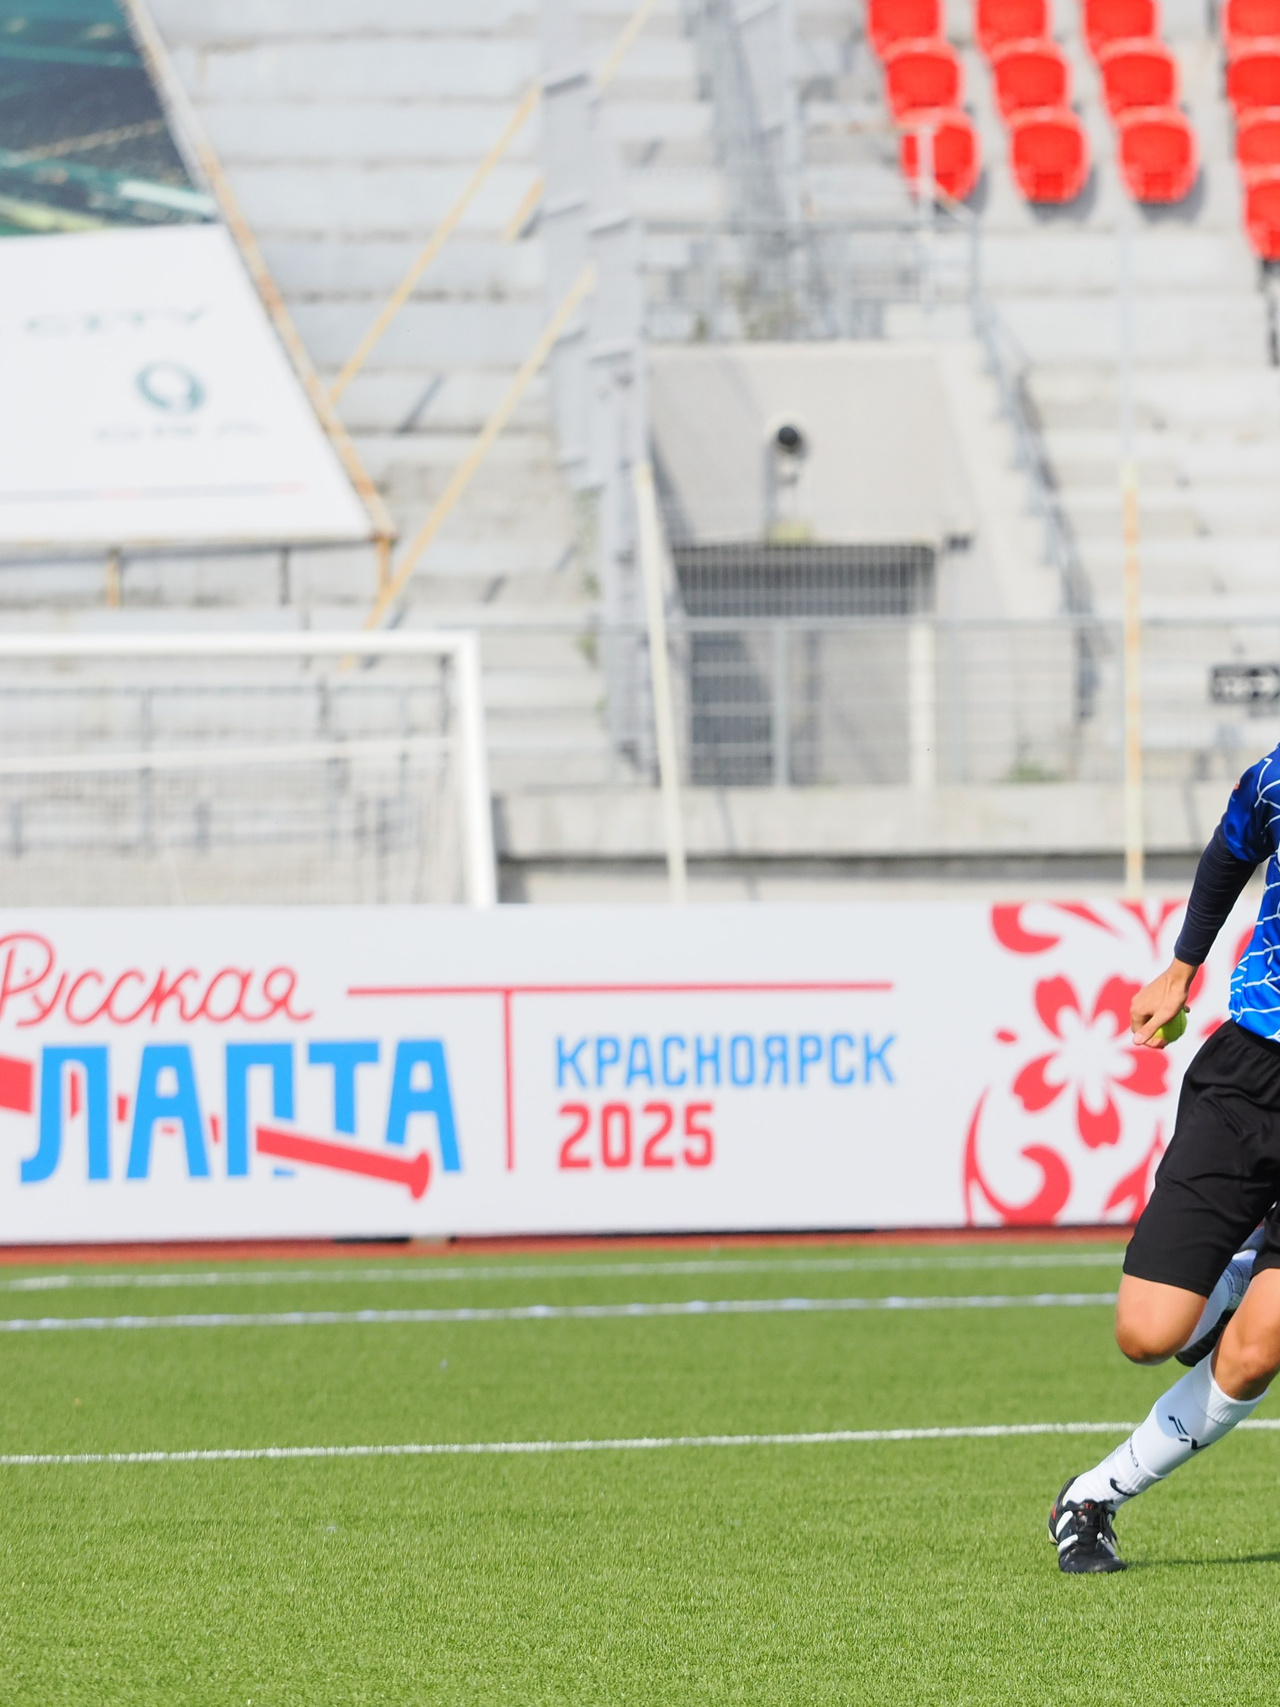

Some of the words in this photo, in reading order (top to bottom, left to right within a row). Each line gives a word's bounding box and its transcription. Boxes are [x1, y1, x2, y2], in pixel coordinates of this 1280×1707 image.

[0, 933, 312, 1027] Русская
[557, 1034, 893, 1087] КРАСНОЯРСК
[20, 1039, 461, 1184] ЛАПТА
[559, 1101, 714, 1170] 2025
